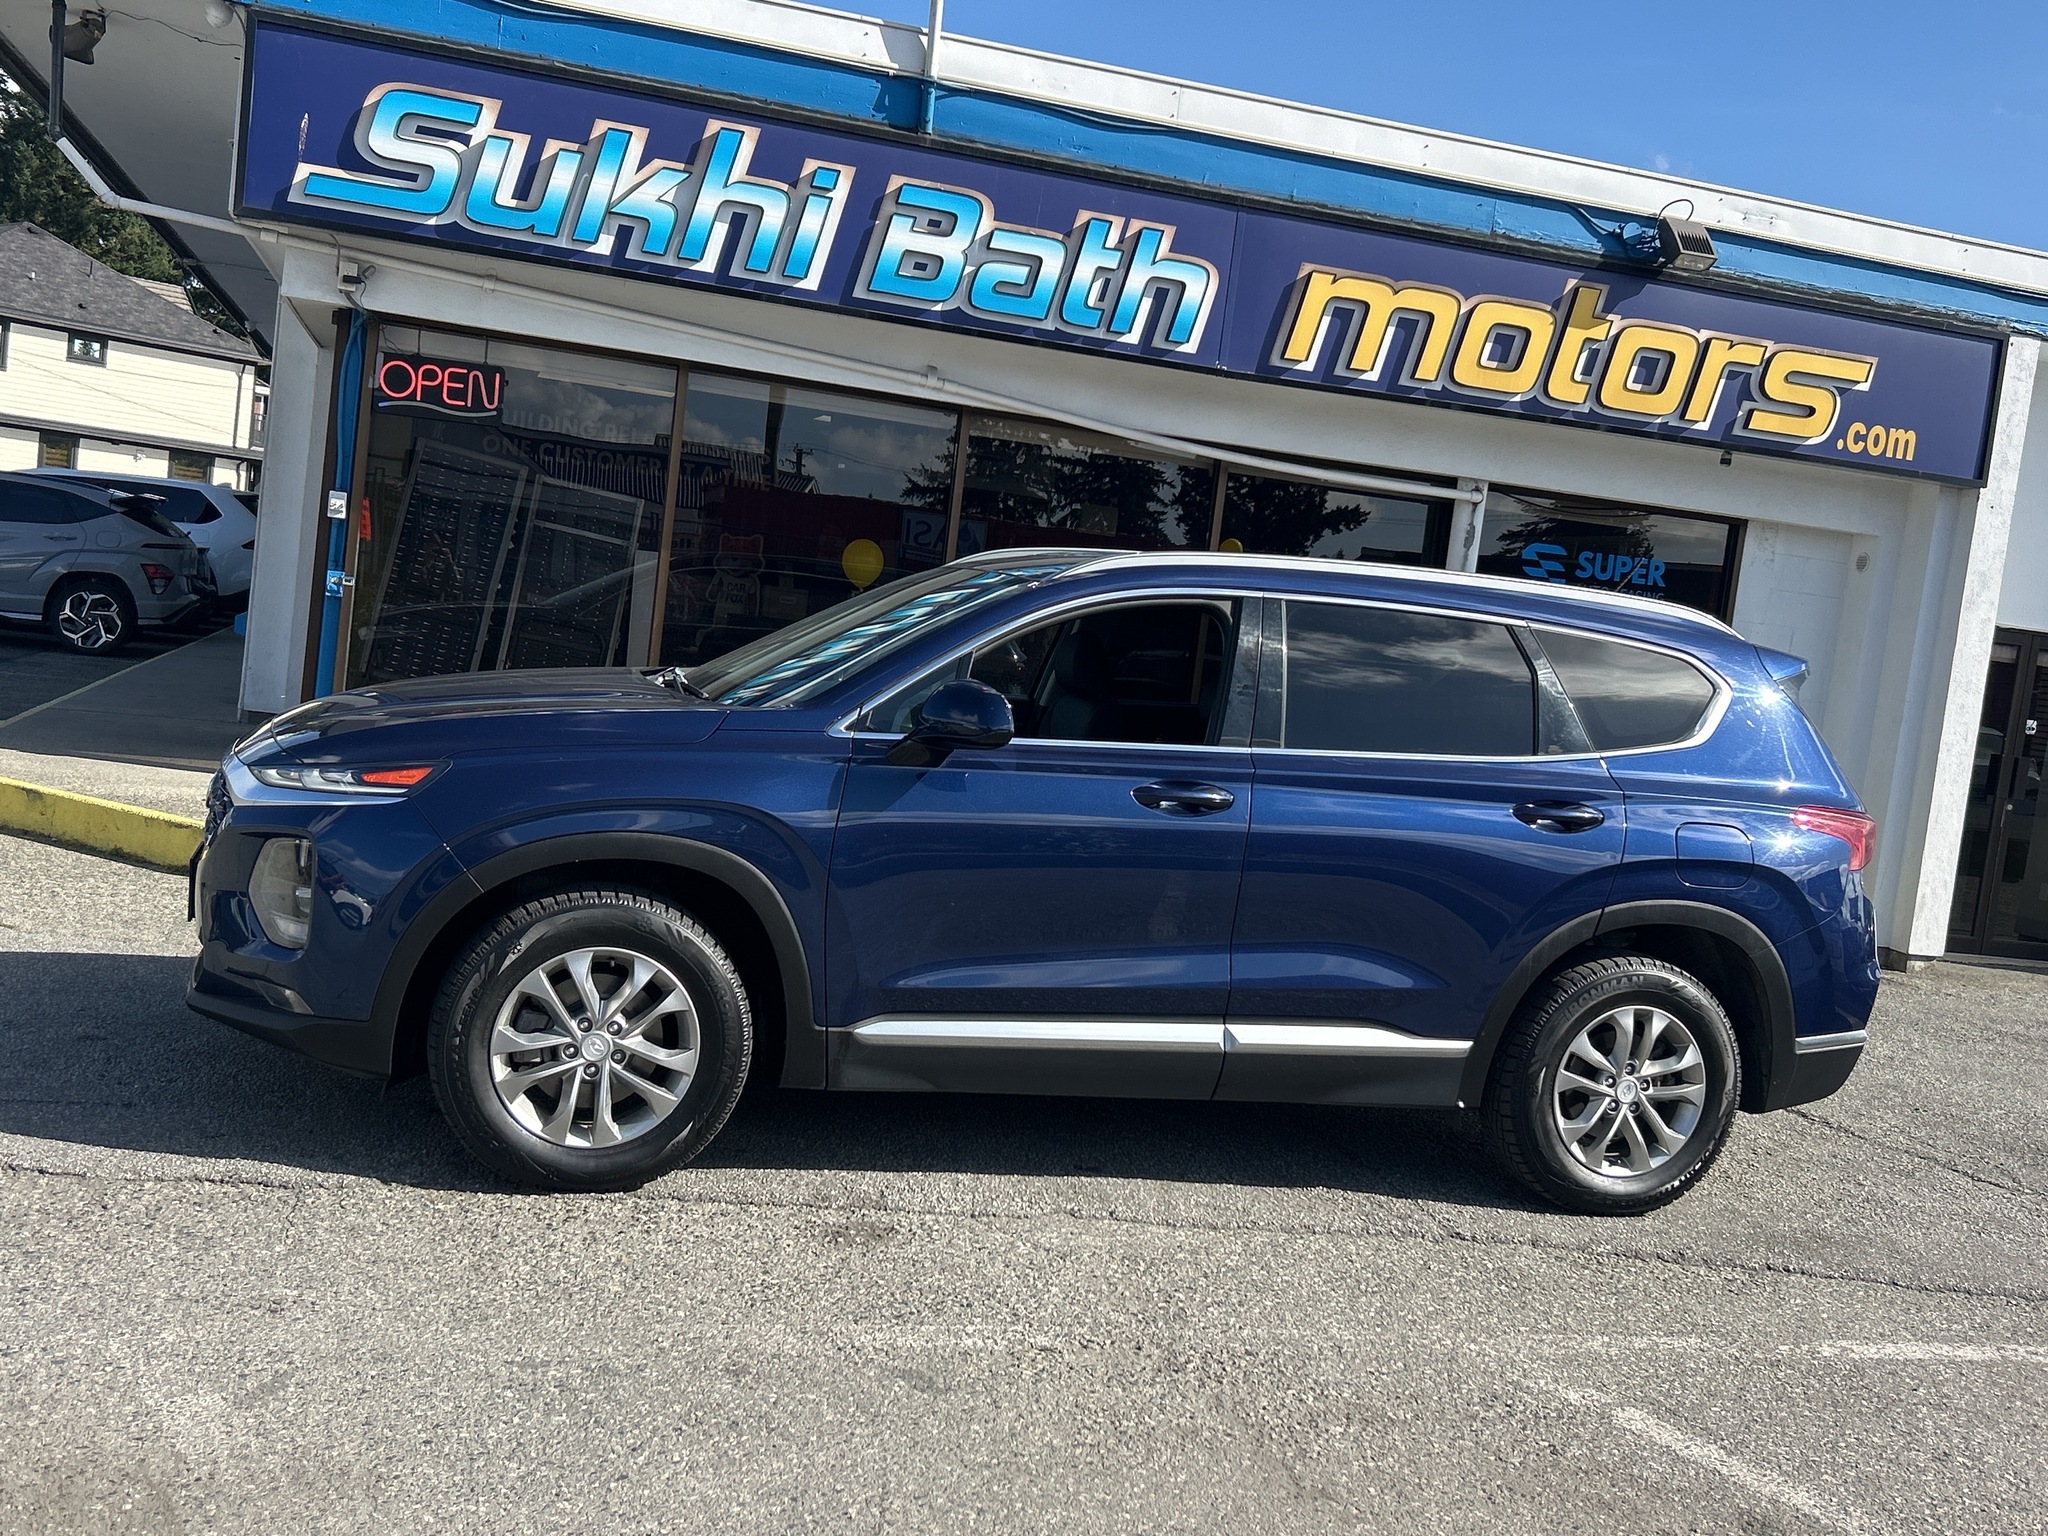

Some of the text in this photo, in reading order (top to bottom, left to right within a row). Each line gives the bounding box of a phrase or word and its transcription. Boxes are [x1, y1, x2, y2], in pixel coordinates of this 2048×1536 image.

[290, 81, 1917, 461] Sukhi Bath motors .com
[379, 360, 500, 410] OPEN
[537, 442, 662, 473] CUSTOMER
[1575, 551, 1666, 588] SUPER
[725, 593, 744, 604] FOX
[726, 581, 746, 593] CAR
